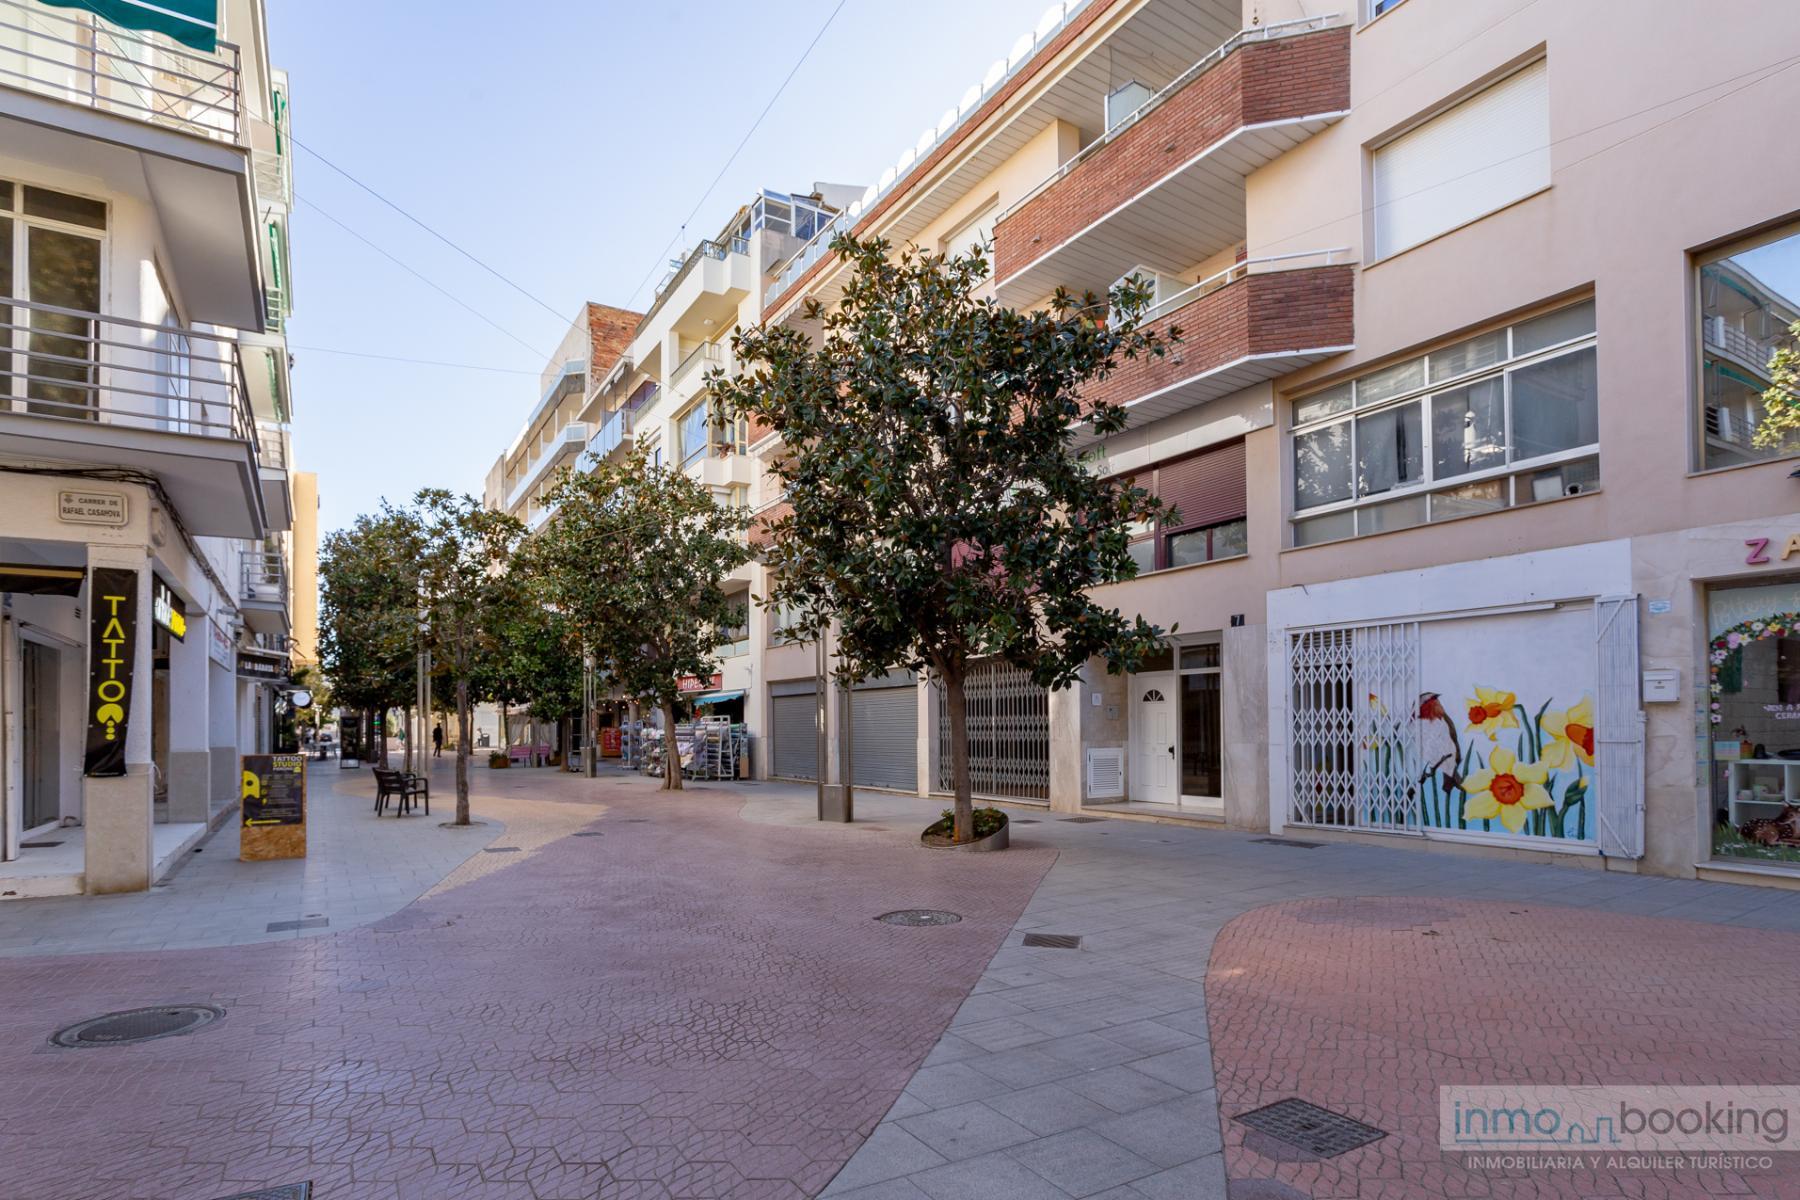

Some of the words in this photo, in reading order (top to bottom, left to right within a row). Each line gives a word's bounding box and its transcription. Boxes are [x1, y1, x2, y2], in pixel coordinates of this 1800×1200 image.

[78, 497, 106, 505] CARRER
[109, 499, 119, 507] DE
[62, 506, 86, 516] RAFAEL
[87, 508, 121, 518] CASANOVA
